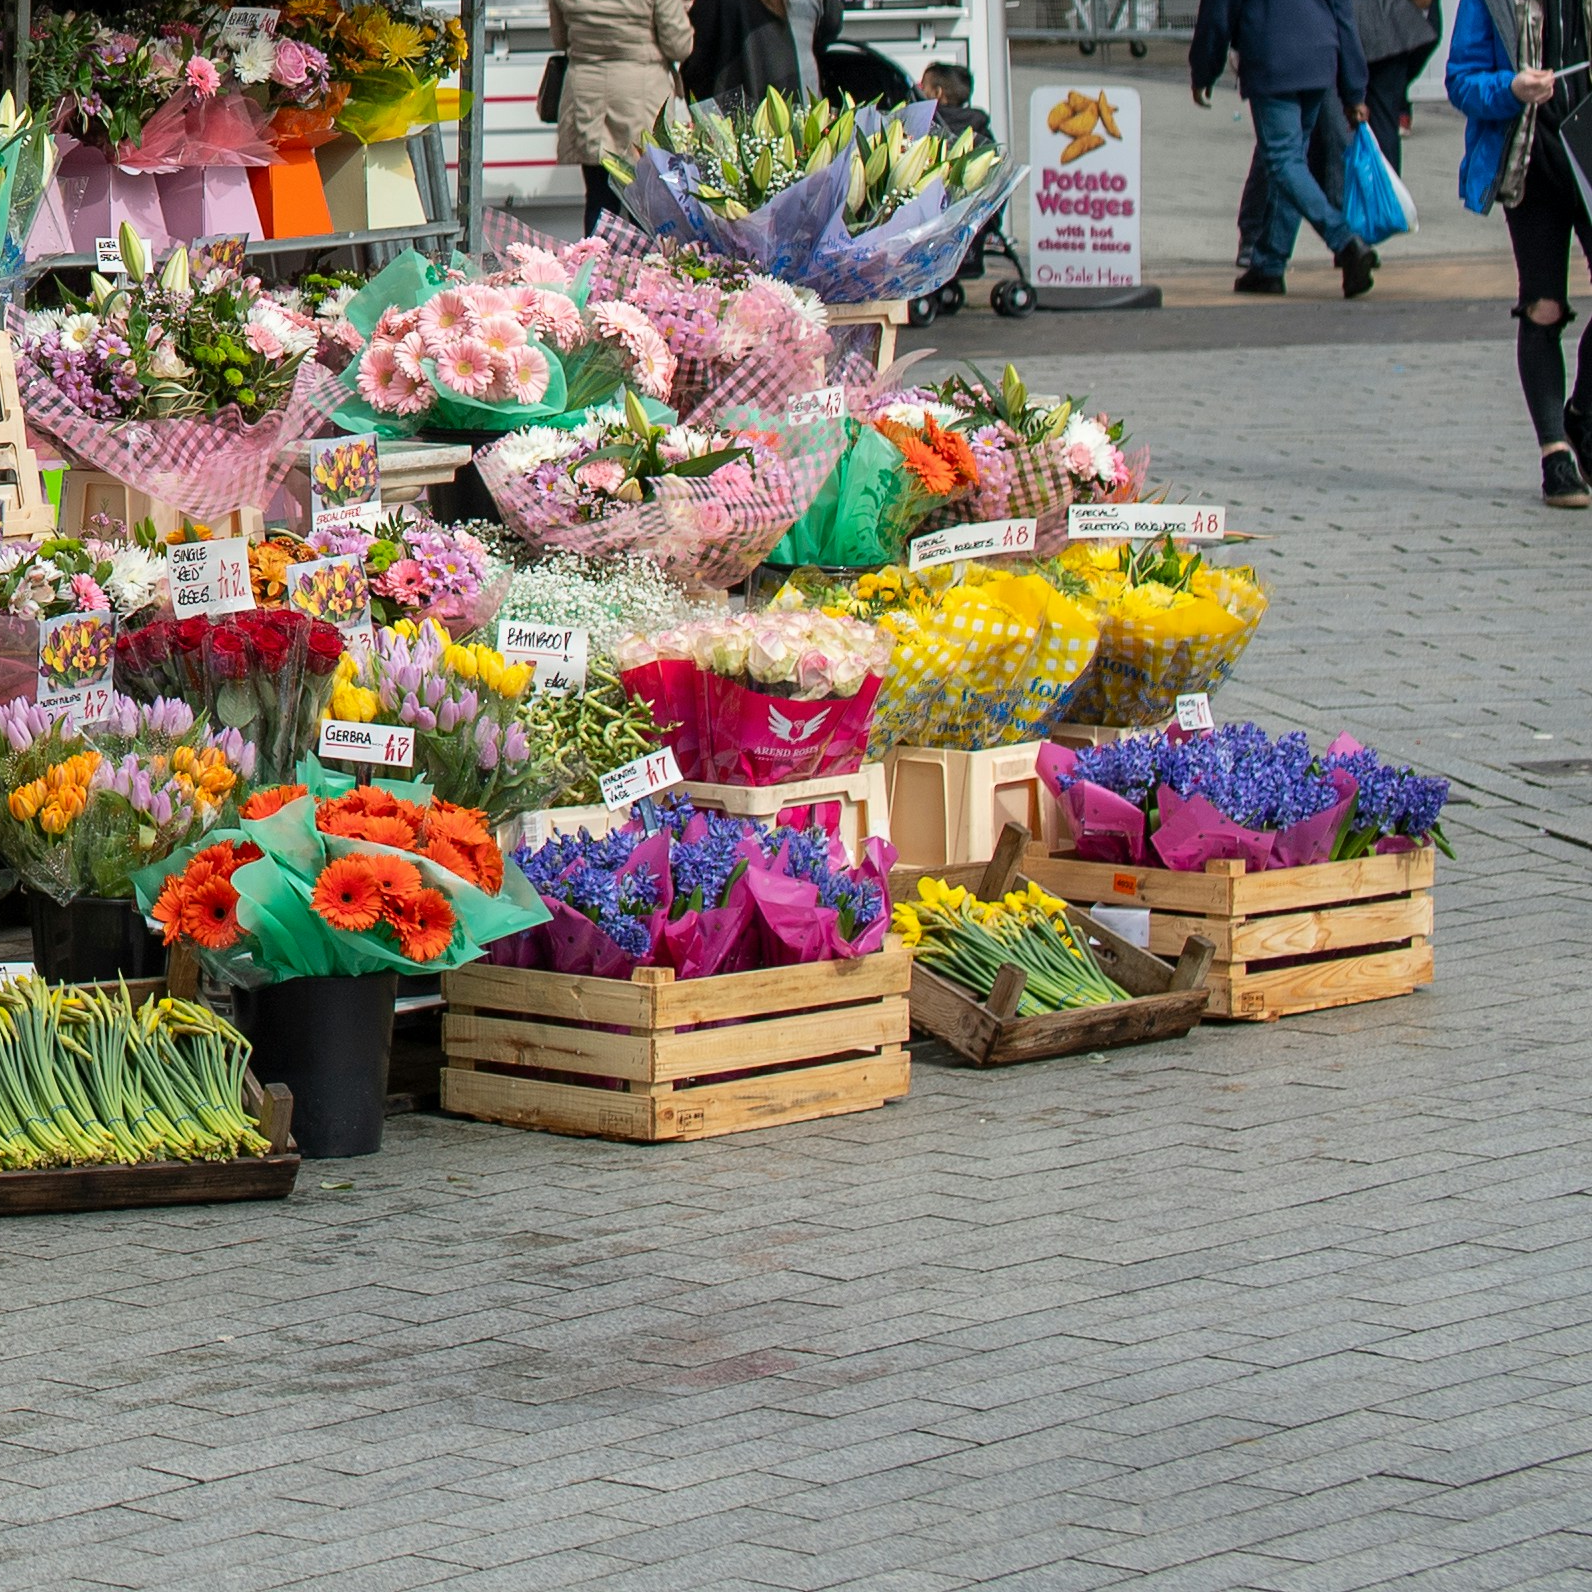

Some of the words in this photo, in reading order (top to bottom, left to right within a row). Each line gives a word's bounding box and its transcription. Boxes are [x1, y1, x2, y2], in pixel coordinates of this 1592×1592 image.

[1041, 167, 1128, 193] Potato
[1035, 191, 1135, 221] Wedges
[1055, 224, 1086, 239] with
[1090, 224, 1114, 239] hot
[1037, 237, 1086, 253] cheese
[1091, 239, 1132, 254] sauce
[1036, 263, 1062, 284] On
[1065, 264, 1094, 286] Sale
[1097, 265, 1135, 288] Here
[172, 546, 208, 564] SINGLE
[324, 724, 372, 745] GERBRA
